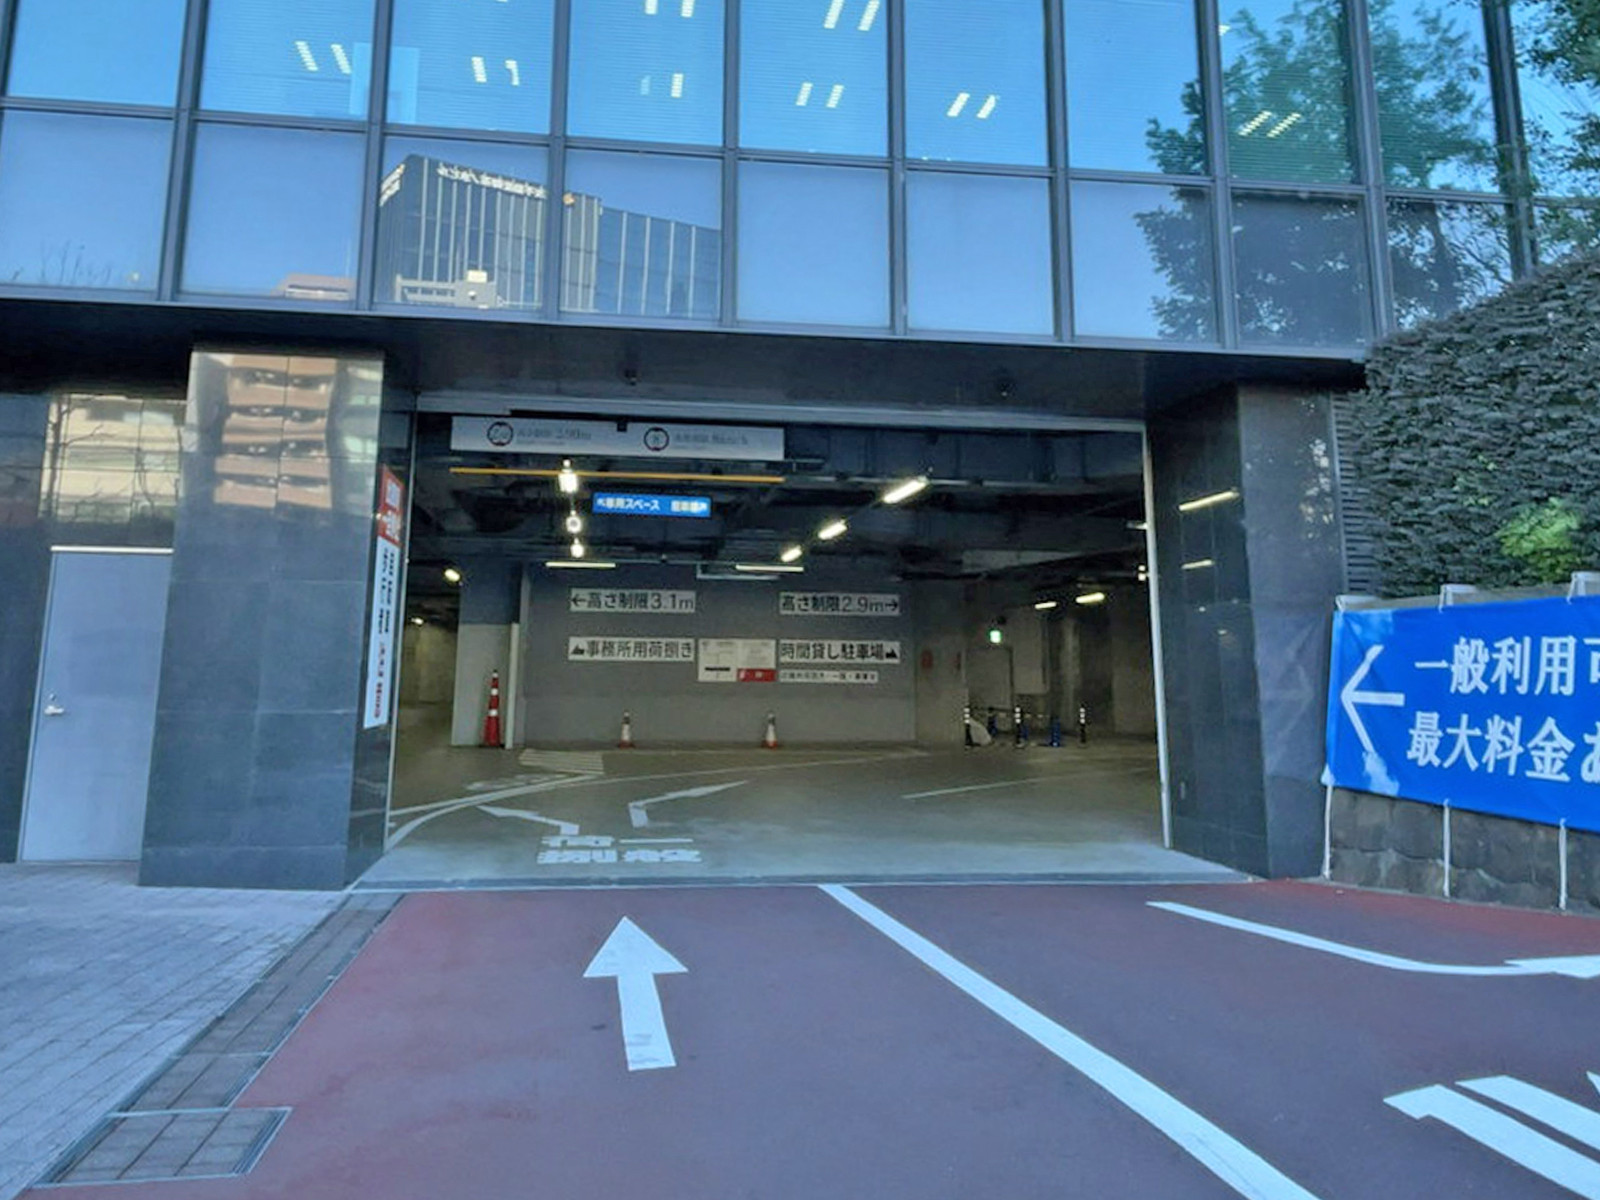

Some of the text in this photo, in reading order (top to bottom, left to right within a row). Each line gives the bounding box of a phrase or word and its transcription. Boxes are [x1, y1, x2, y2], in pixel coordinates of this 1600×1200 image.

[587, 591, 694, 610] 高さ制限3.1m
[782, 594, 884, 613] 高さ制限2.9m
[587, 640, 691, 659] 事務所用荷捌き
[780, 642, 884, 660] 時間貸し駐車場
